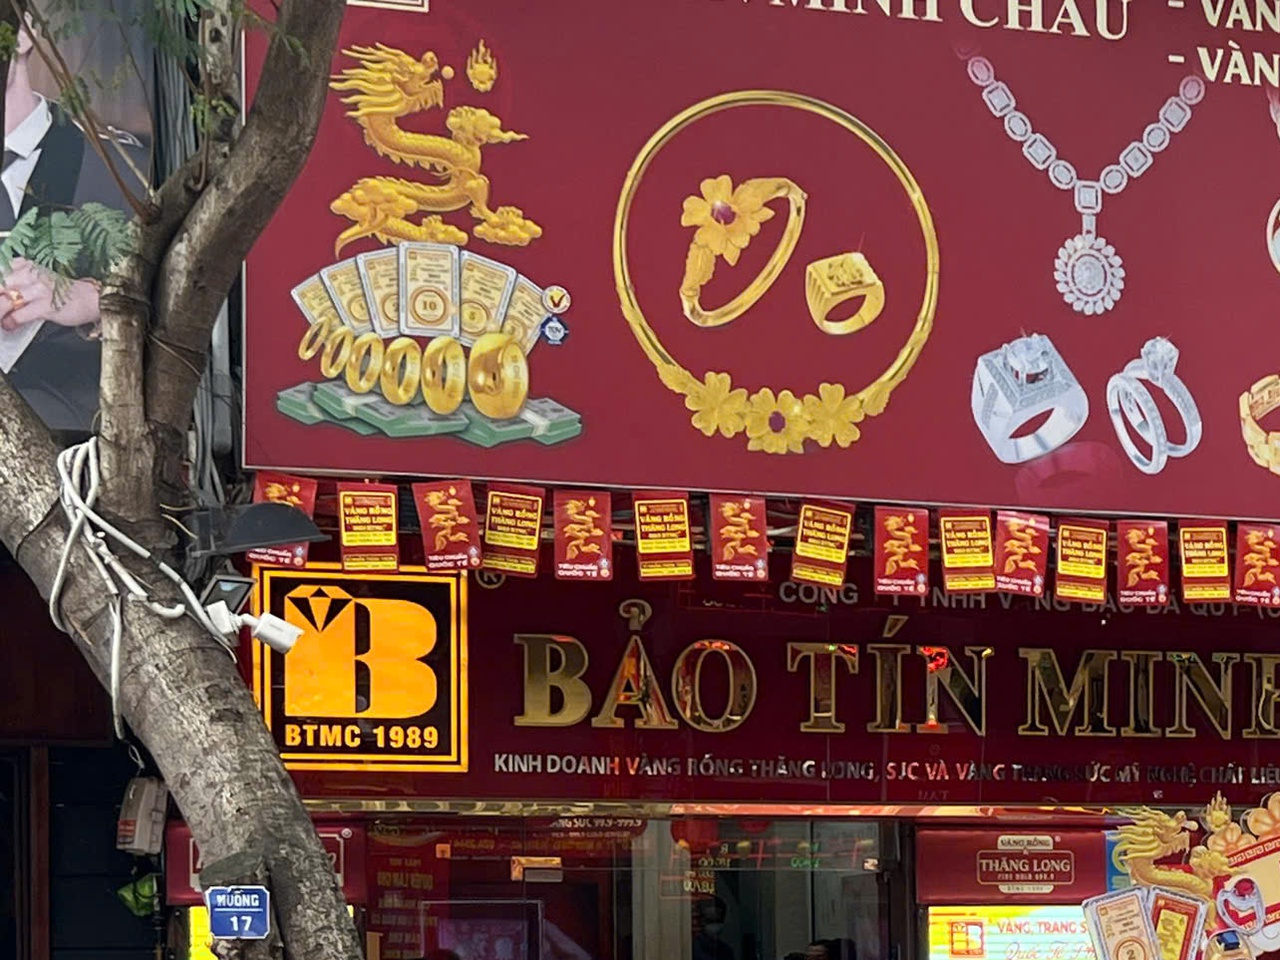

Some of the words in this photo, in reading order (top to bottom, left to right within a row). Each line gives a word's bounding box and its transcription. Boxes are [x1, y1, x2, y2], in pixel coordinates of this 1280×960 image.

[513, 599, 758, 733] BẢO
[787, 615, 995, 736] TÍN
[285, 724, 361, 747] BTMC
[373, 725, 438, 748] 1989
[494, 754, 542, 774] KINH
[546, 755, 619, 775] DOANH
[626, 753, 680, 776] VÀNG
[886, 761, 919, 781] SJC
[925, 758, 949, 781] VÀ
[956, 758, 1006, 782] VÀNG
[980, 857, 1030, 872] THĂNG
[1033, 859, 1071, 872] LONG
[230, 916, 252, 931] 17
[1037, 920, 1077, 934] TRANG
[1126, 949, 1135, 960] 2
